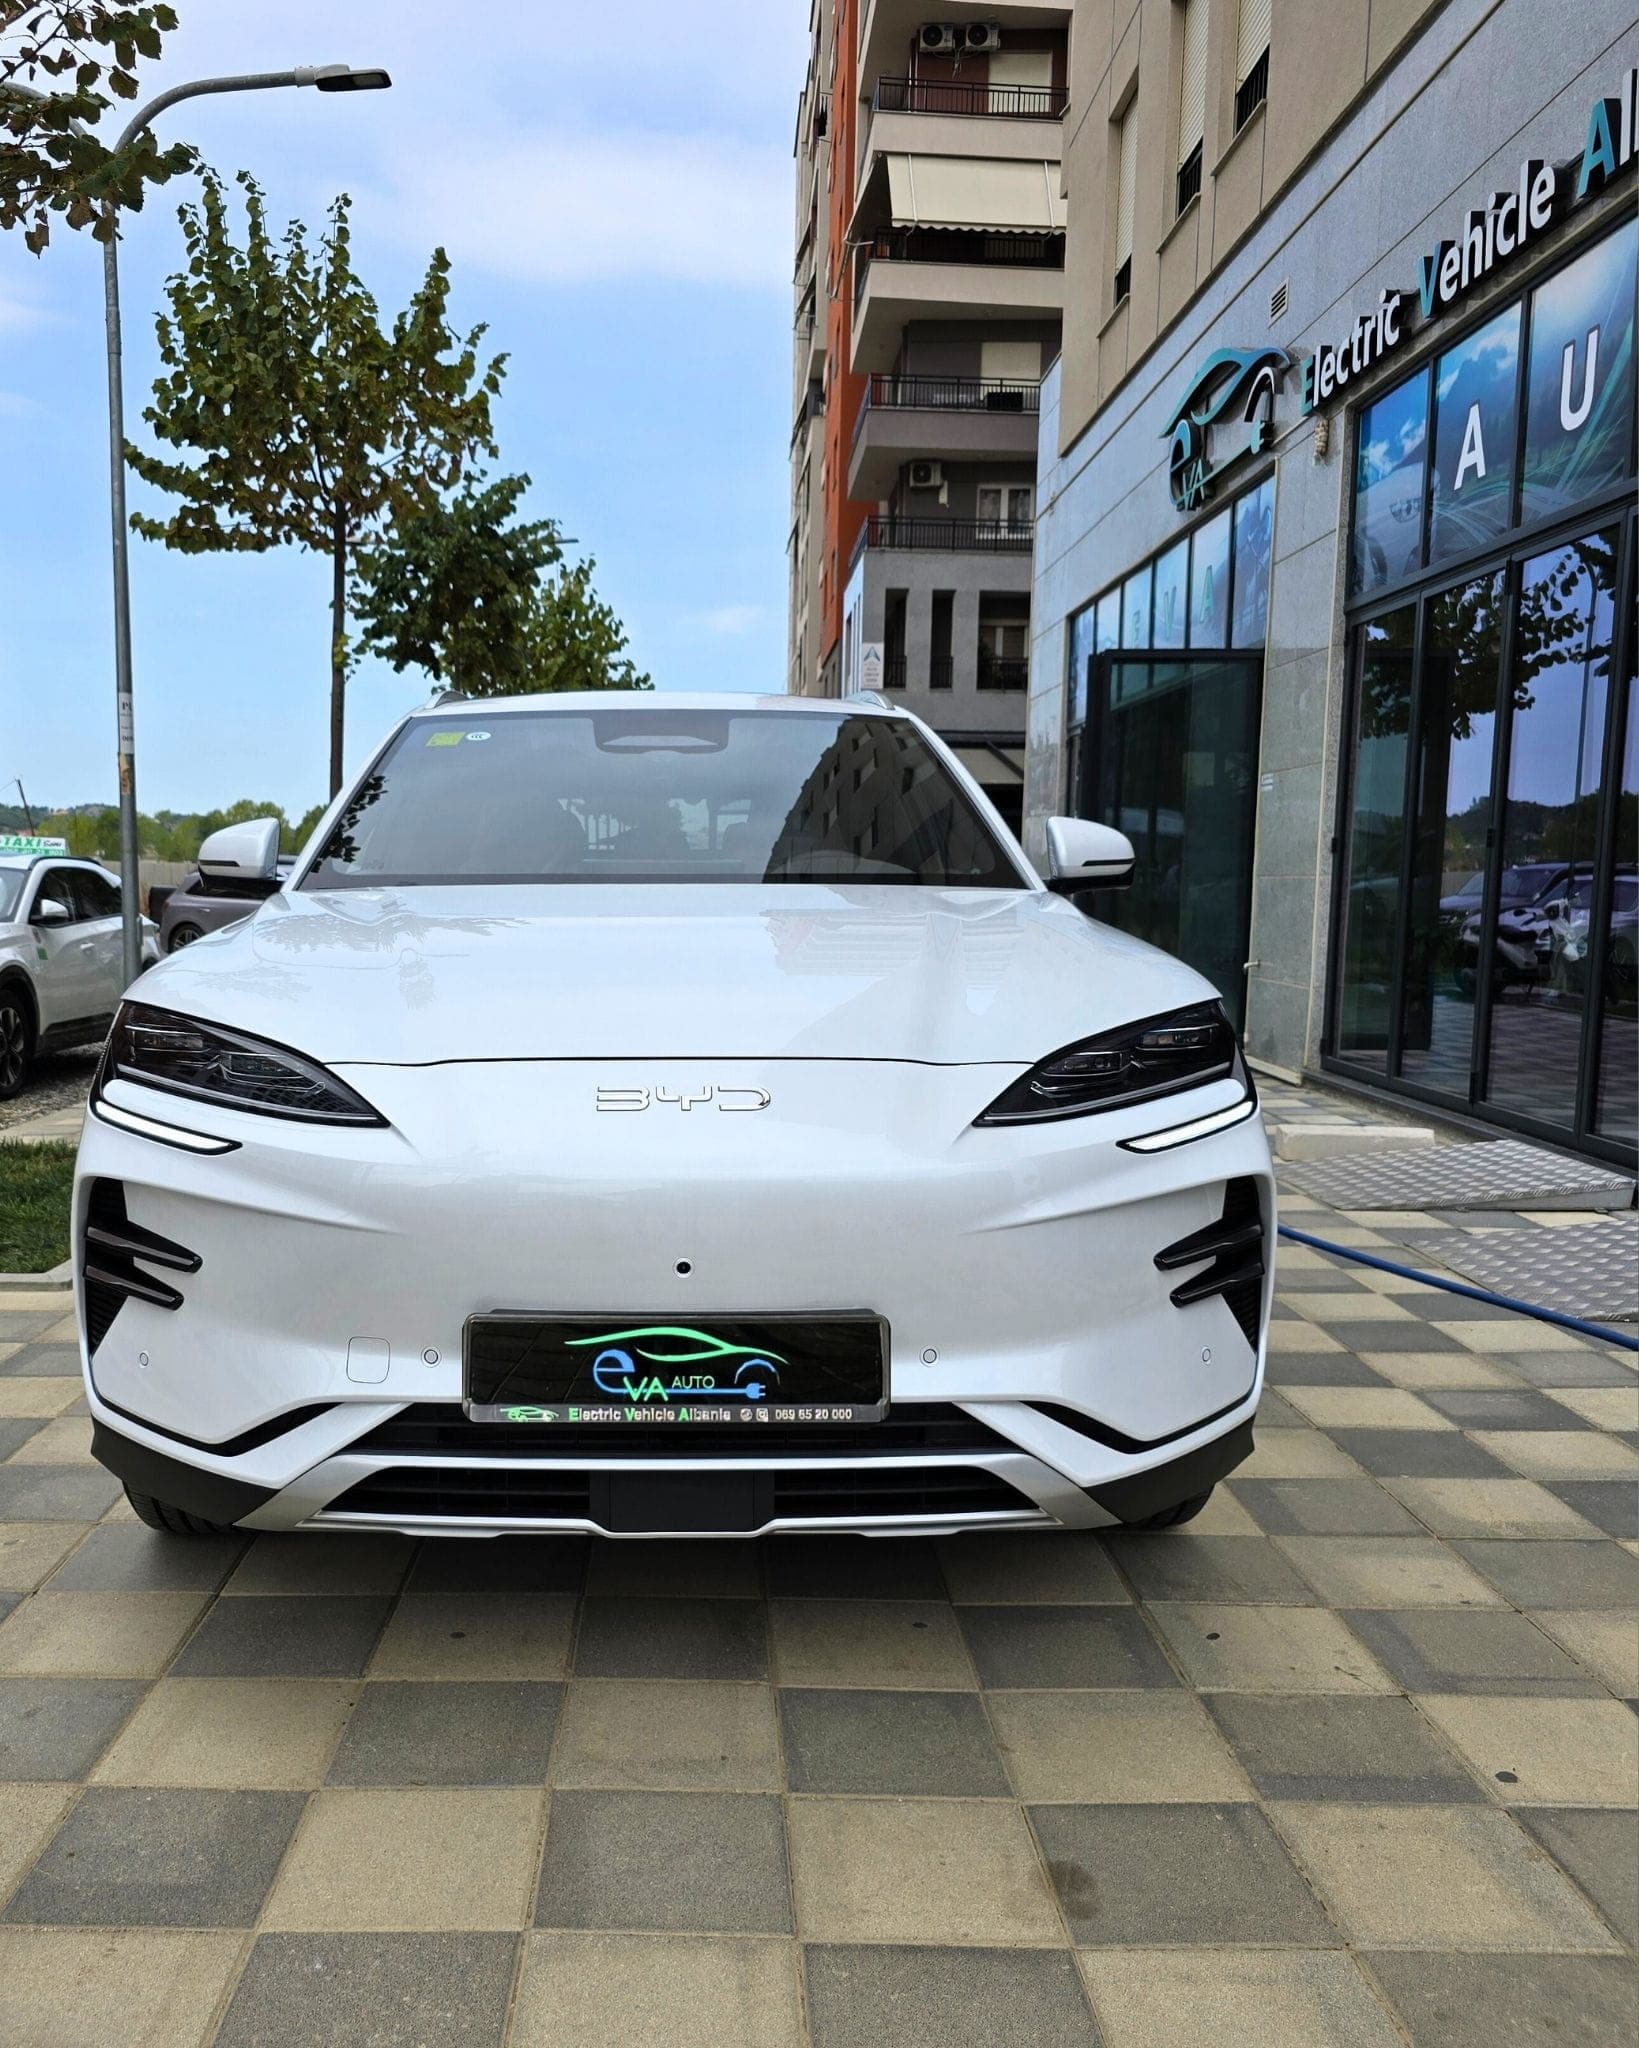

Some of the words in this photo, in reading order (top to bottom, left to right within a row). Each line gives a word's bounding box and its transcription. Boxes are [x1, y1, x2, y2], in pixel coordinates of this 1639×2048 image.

[1301, 289, 1401, 418] Electric
[1416, 160, 1556, 319] Vehicle
[5, 837, 42, 847] TAXI
[597, 1086, 771, 1112] BYD
[671, 1375, 715, 1389] AUTO
[568, 1407, 621, 1421] Electric
[624, 1407, 675, 1421] Vehicle
[678, 1407, 731, 1421] Albania
[775, 1408, 796, 1420] 069
[815, 1408, 828, 1420] 20
[831, 1408, 853, 1420] 000
